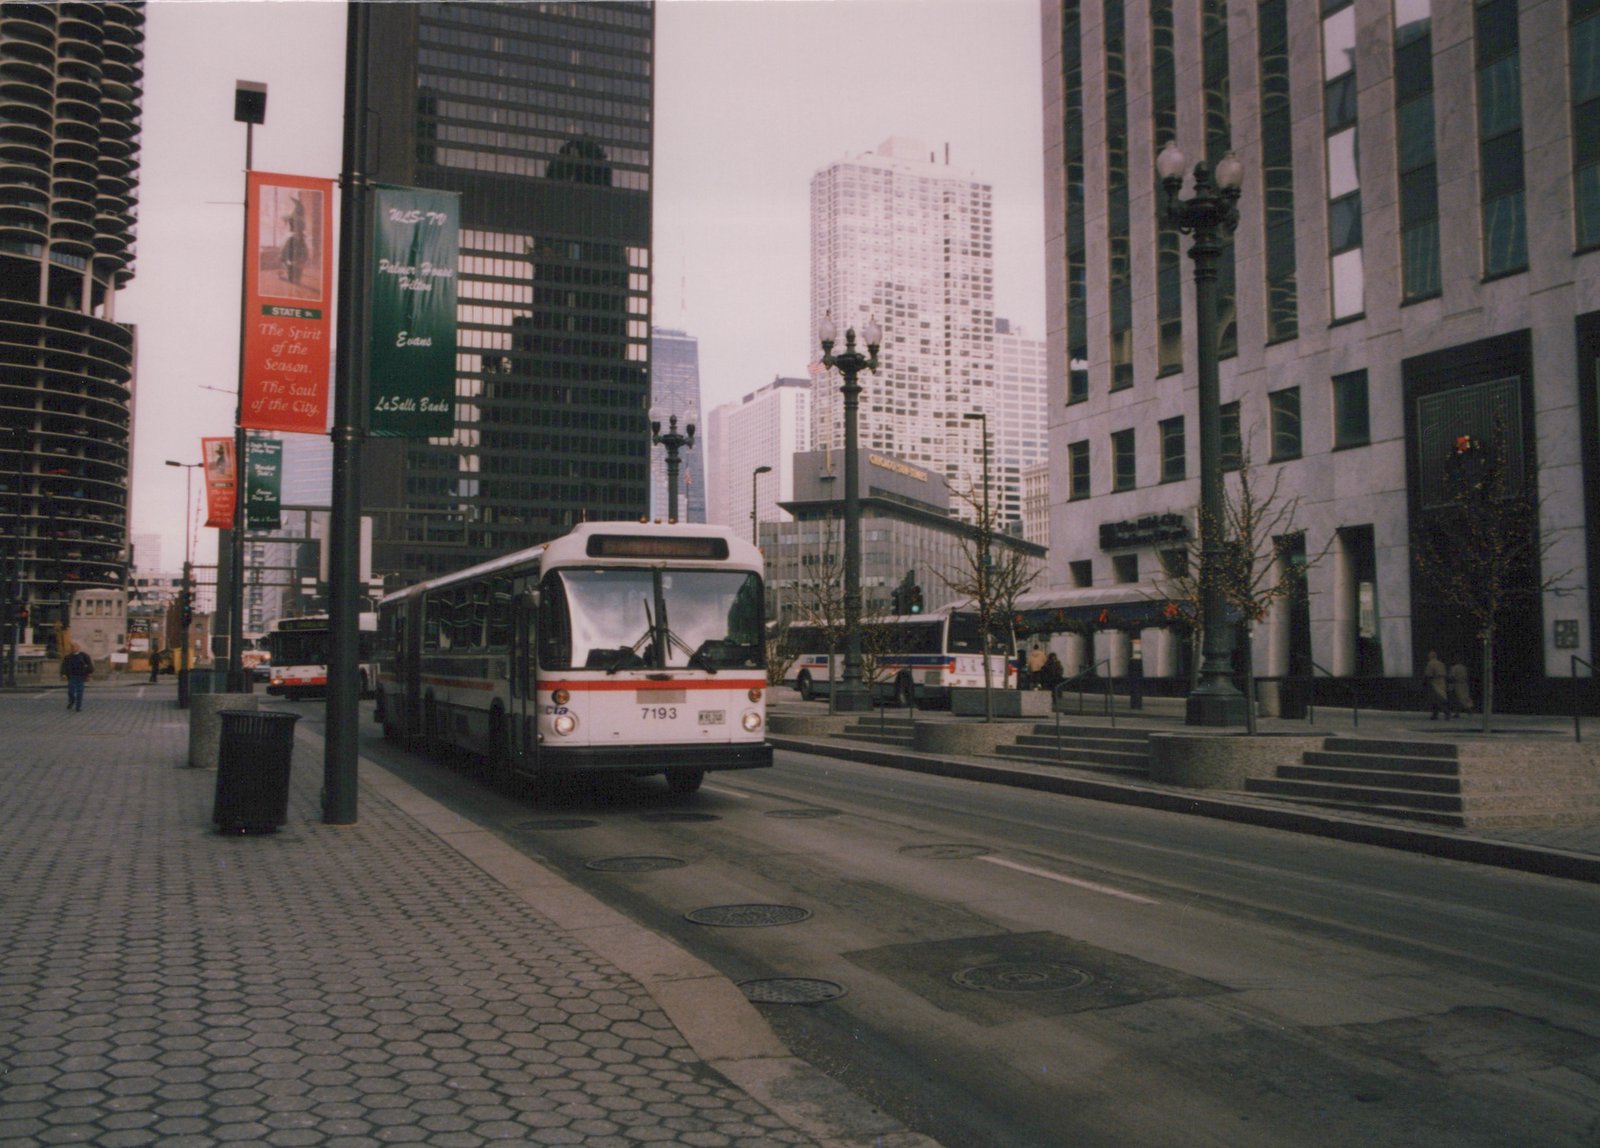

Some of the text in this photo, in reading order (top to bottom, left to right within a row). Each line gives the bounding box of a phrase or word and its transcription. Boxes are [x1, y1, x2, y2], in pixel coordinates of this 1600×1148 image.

[379, 258, 453, 277] Palmer House
[398, 276, 432, 291] Hilton
[271, 306, 302, 318] STATE
[258, 322, 322, 340] The Spirit
[396, 331, 432, 348] Evans
[271, 340, 308, 357] of the
[260, 381, 318, 397] The Soul
[251, 397, 268, 414] of
[268, 398, 288, 412] the
[375, 396, 449, 412] LaSalle Banks
[641, 707, 678, 720] 7193
